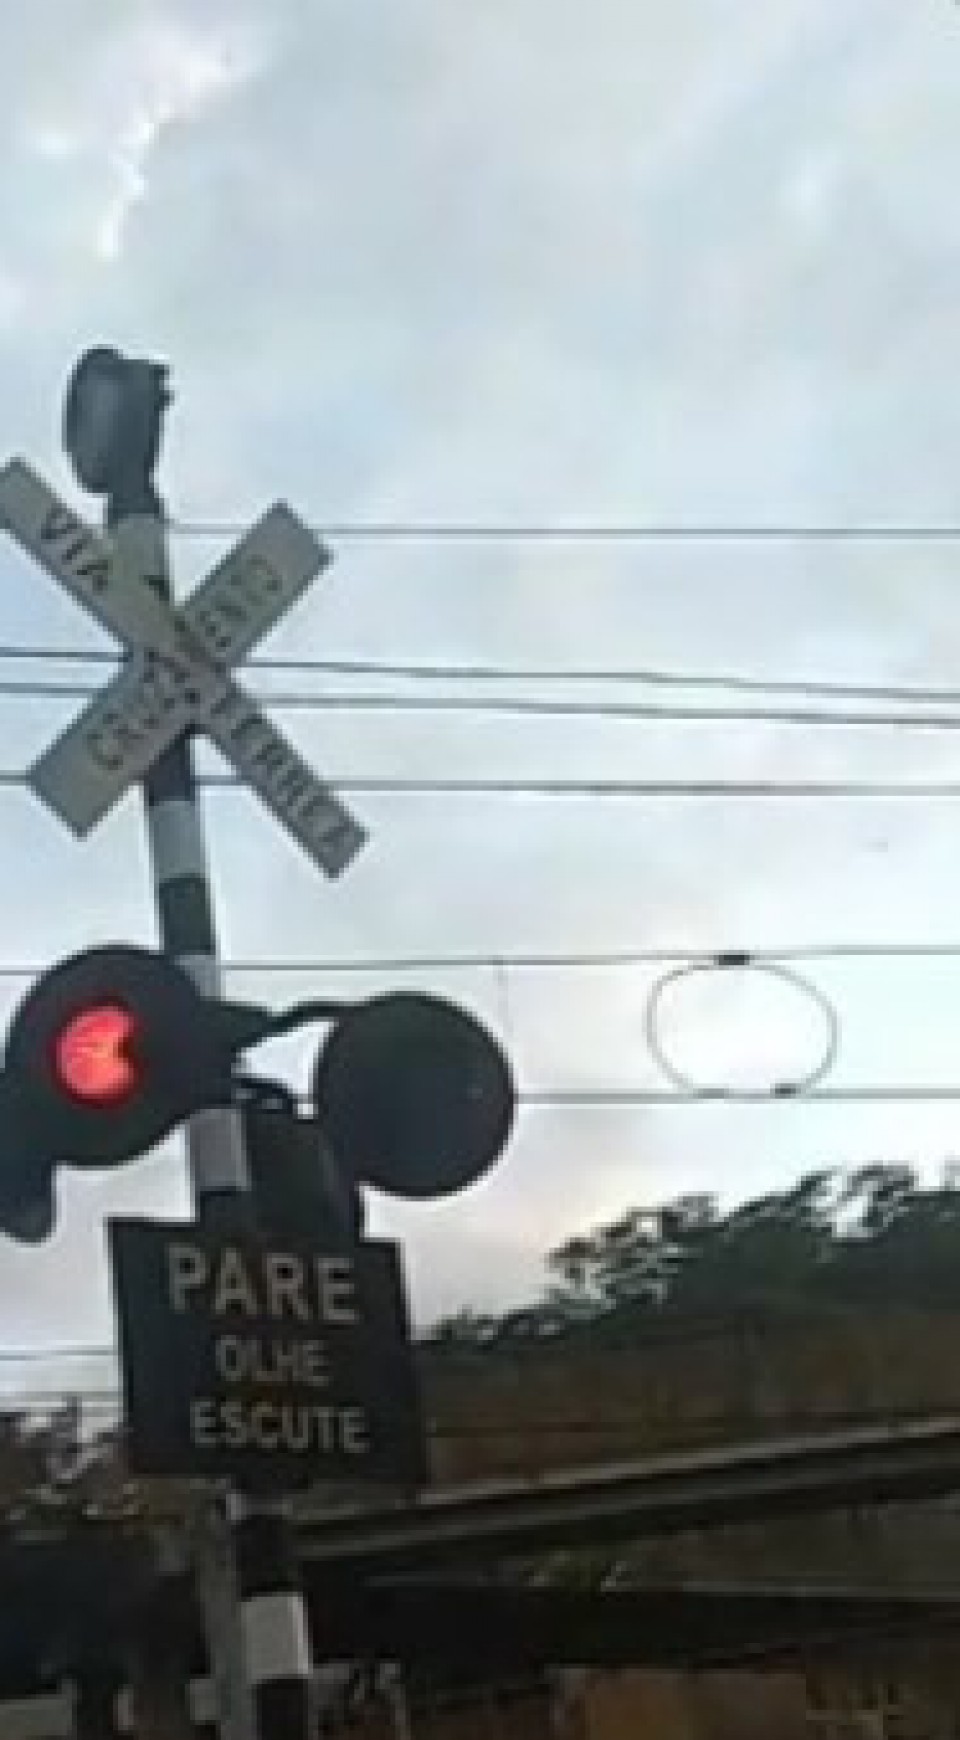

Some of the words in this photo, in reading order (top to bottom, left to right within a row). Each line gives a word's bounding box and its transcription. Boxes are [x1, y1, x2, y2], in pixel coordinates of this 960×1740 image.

[42, 507, 109, 593] VIA
[168, 1245, 358, 1323] PARE
[217, 1336, 327, 1385] OLHE
[193, 1402, 369, 1452] ESCUTE
